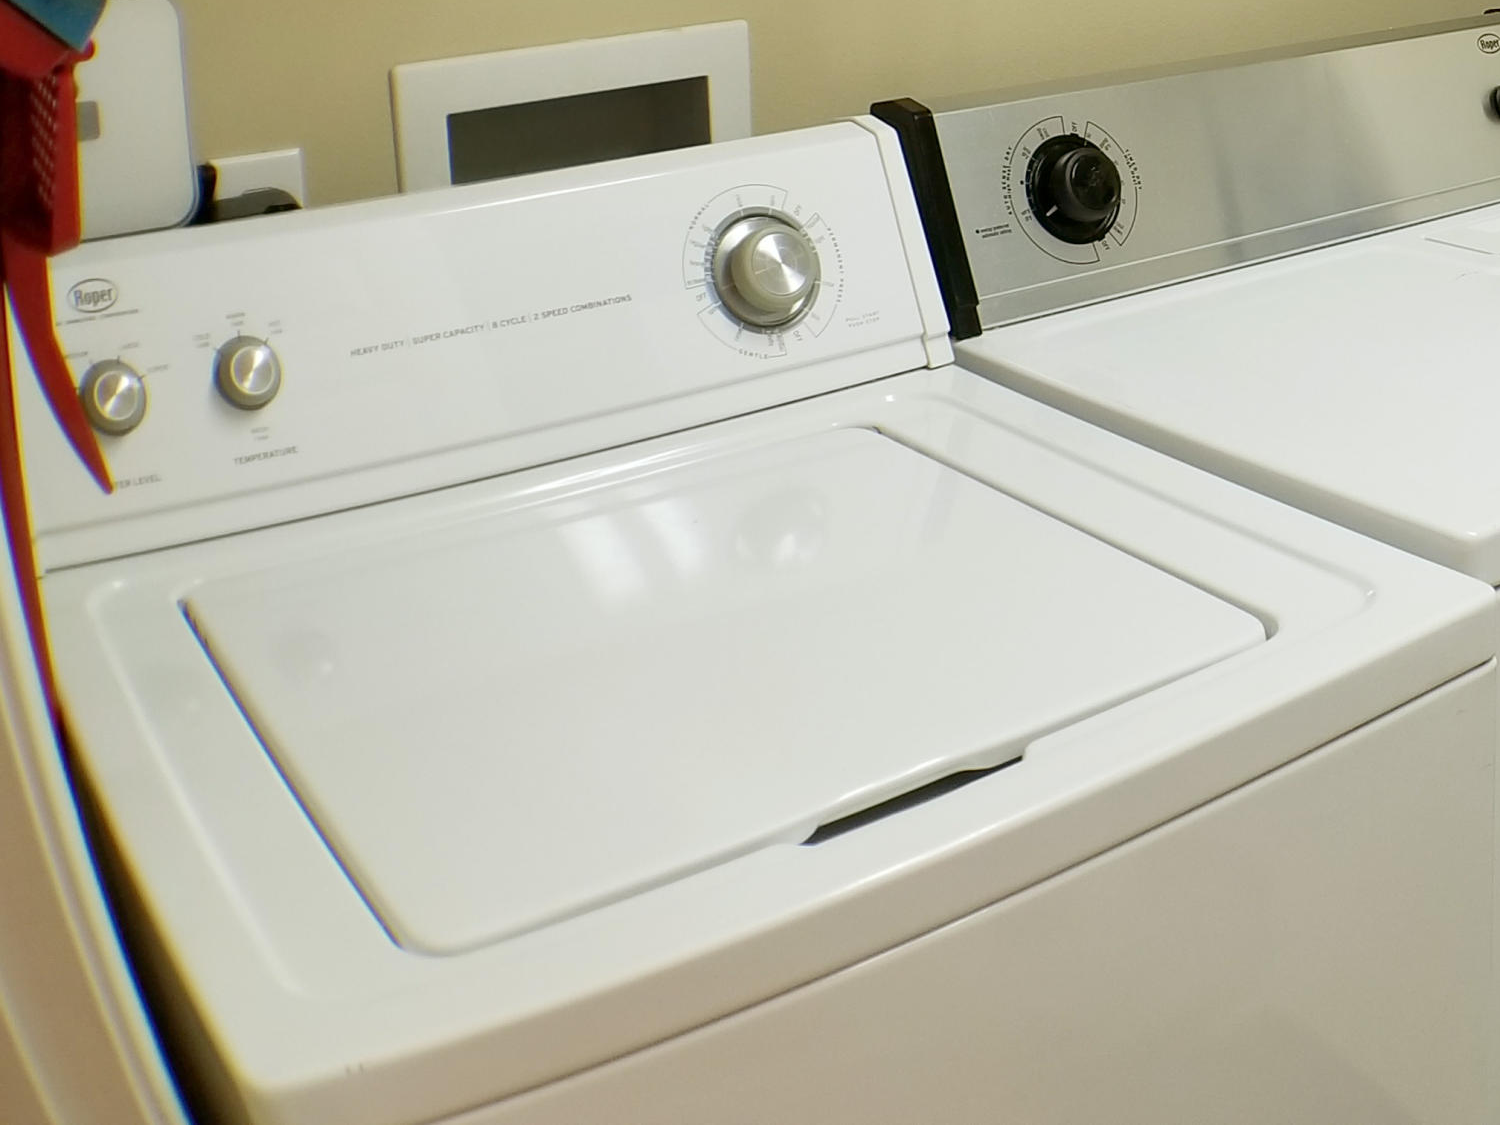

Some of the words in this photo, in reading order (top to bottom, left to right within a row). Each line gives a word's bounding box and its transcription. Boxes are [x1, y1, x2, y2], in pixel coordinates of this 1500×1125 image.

[1480, 38, 1500, 51] Roper
[73, 286, 113, 307] Roper
[349, 344, 379, 358] HEAVY
[380, 339, 405, 352] DUTY
[412, 331, 441, 346] SUPER
[442, 323, 485, 339] CAPACITY
[499, 315, 527, 328] CYCLE
[541, 306, 569, 320] SPEED
[570, 293, 633, 314] COMBINATIONS
[233, 445, 299, 466] TEMPERATURE
[133, 474, 162, 486] LEVEL
